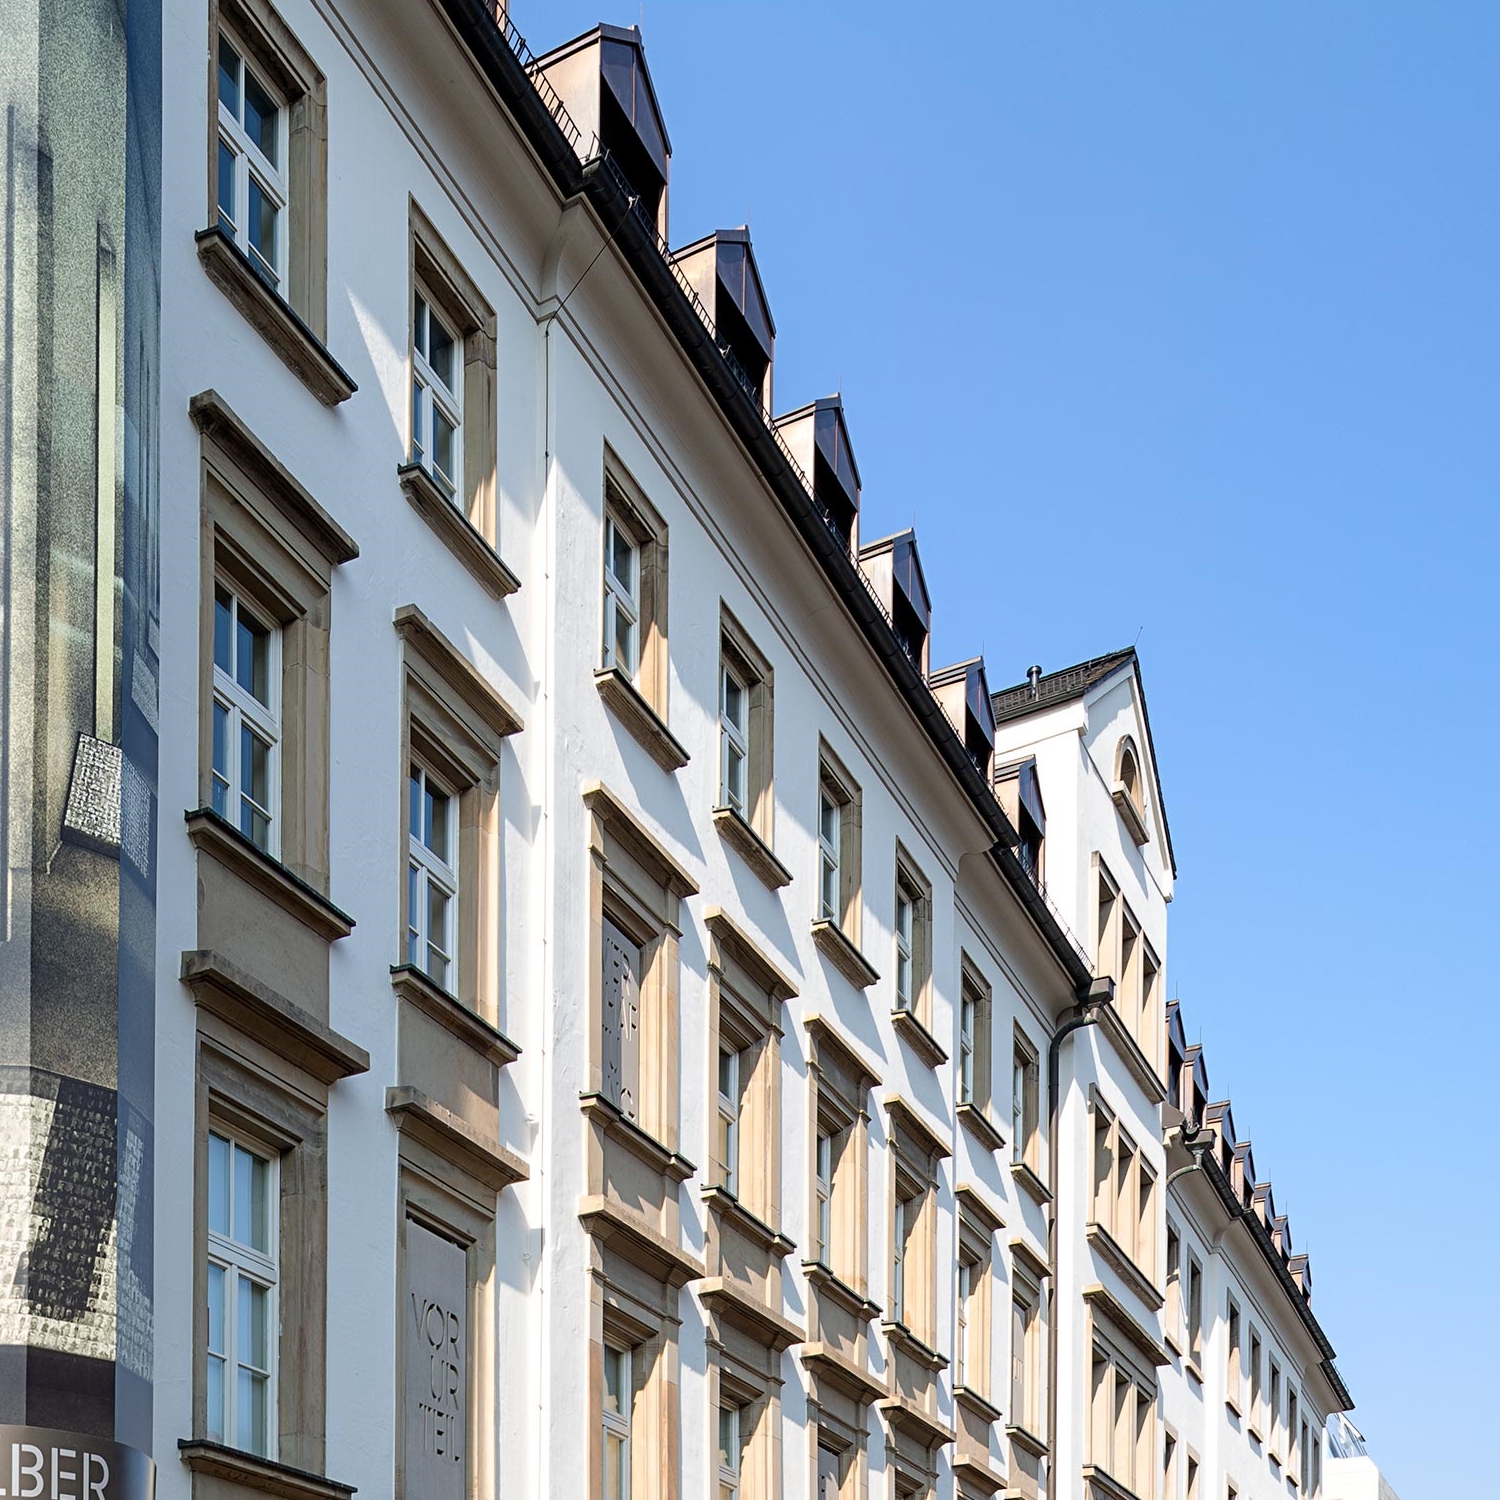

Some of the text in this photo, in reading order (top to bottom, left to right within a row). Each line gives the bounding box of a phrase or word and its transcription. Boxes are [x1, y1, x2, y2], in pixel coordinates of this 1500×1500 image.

[411, 1292, 460, 1360] VOR
[430, 1355, 460, 1411] UR
[419, 1402, 461, 1462] TEIL
